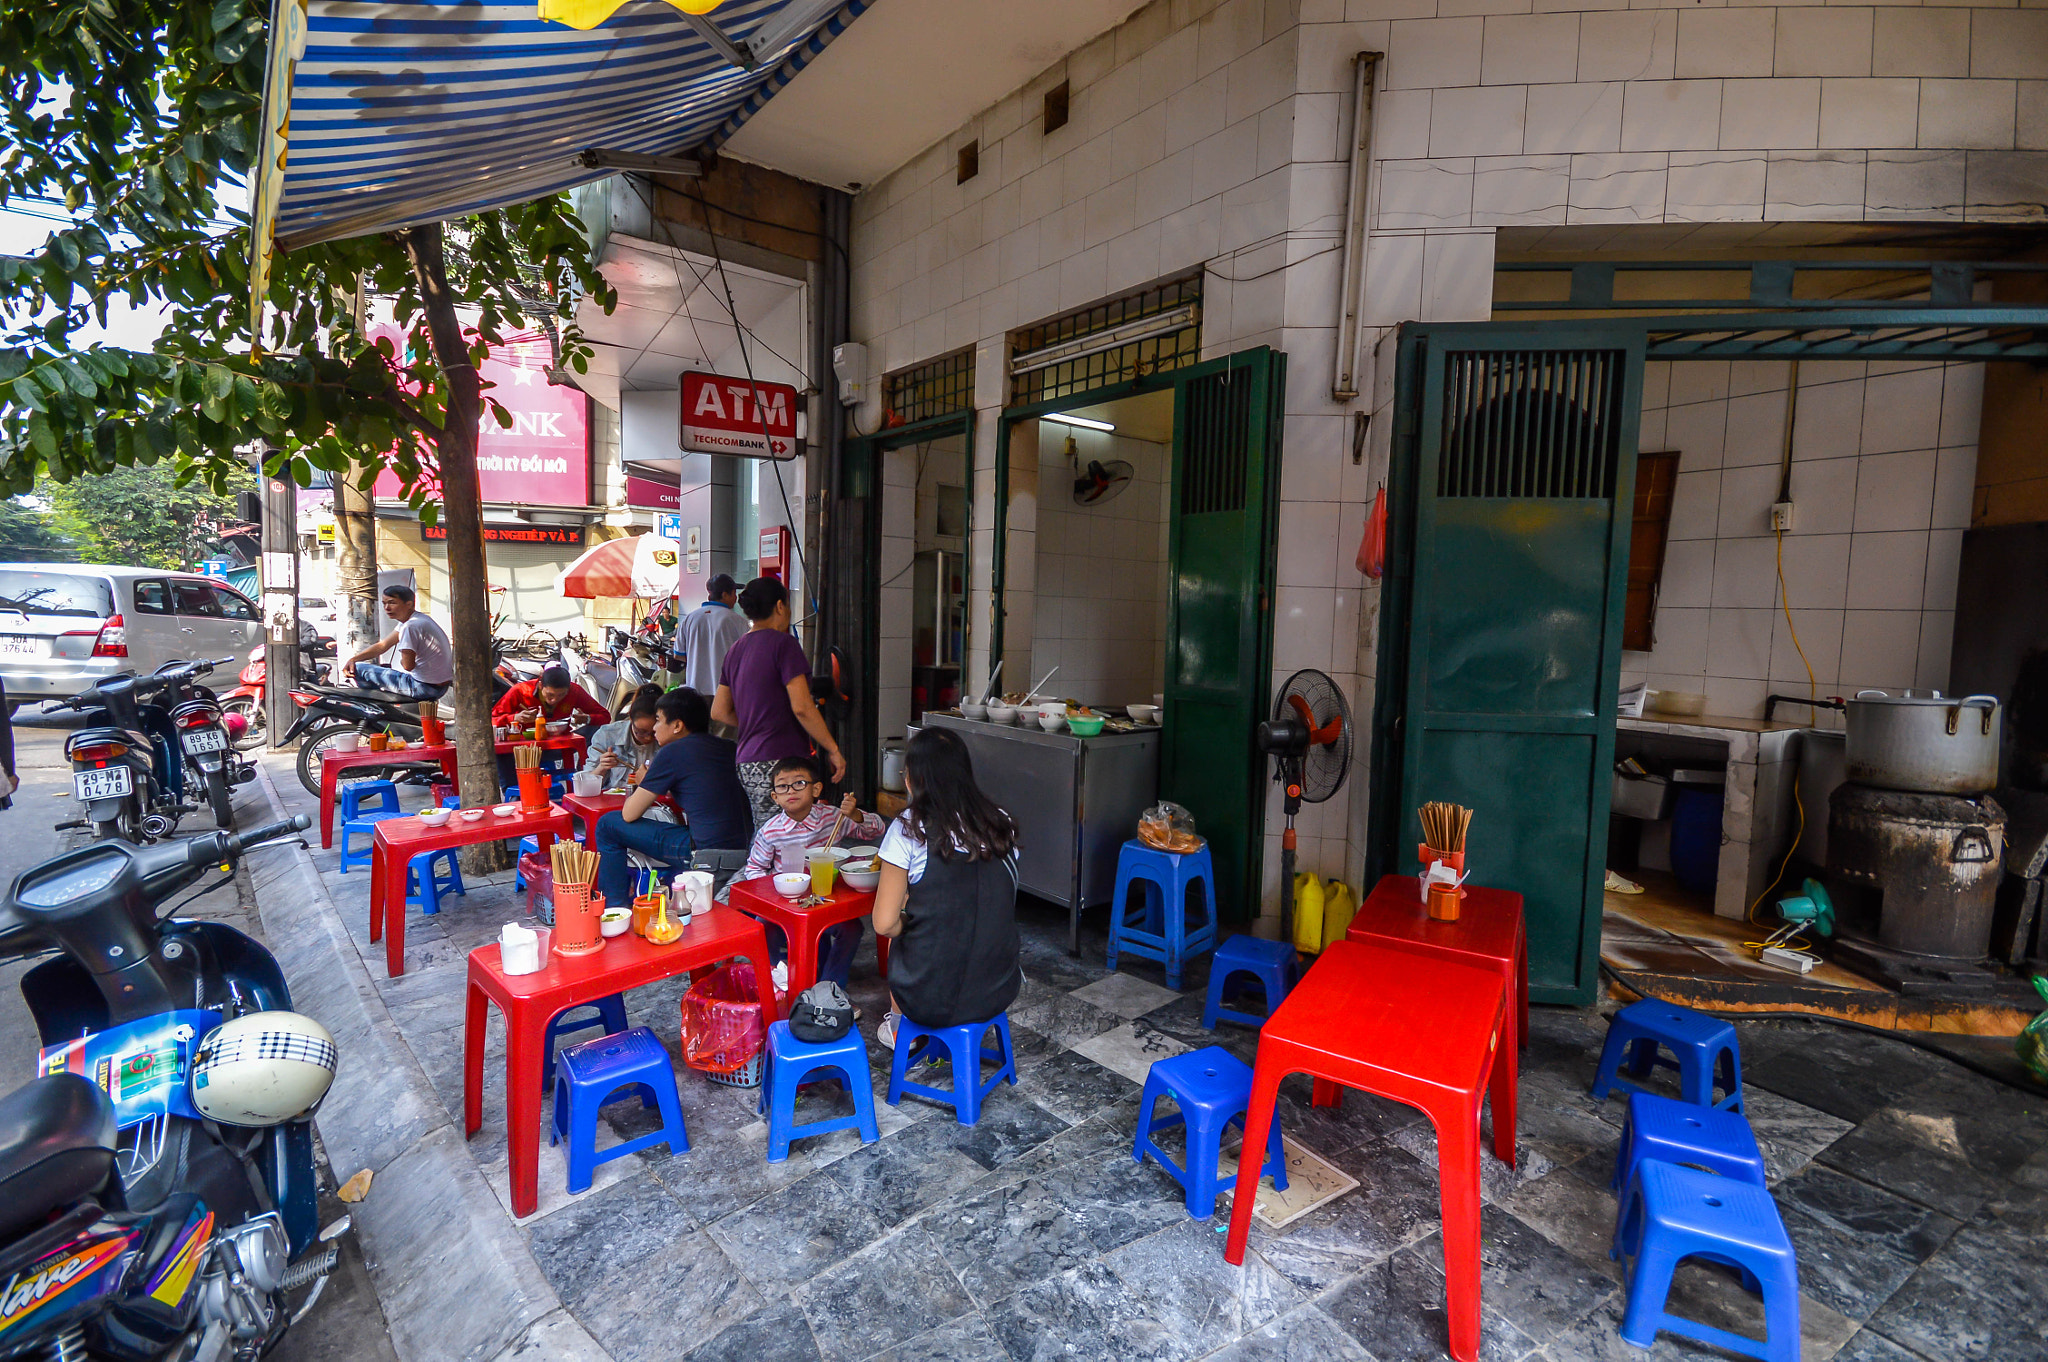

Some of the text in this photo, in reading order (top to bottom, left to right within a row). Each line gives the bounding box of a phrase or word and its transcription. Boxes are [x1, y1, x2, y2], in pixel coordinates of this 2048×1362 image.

[694, 382, 788, 427] ATM
[694, 435, 765, 449] TECHCOMBANK
[548, 529, 567, 541] VÀ
[209, 563, 220, 574] P
[190, 732, 218, 743] 89-K6
[193, 740, 220, 752] 1651
[84, 782, 122, 797] 0478
[29, 1251, 71, 1275] HONDA
